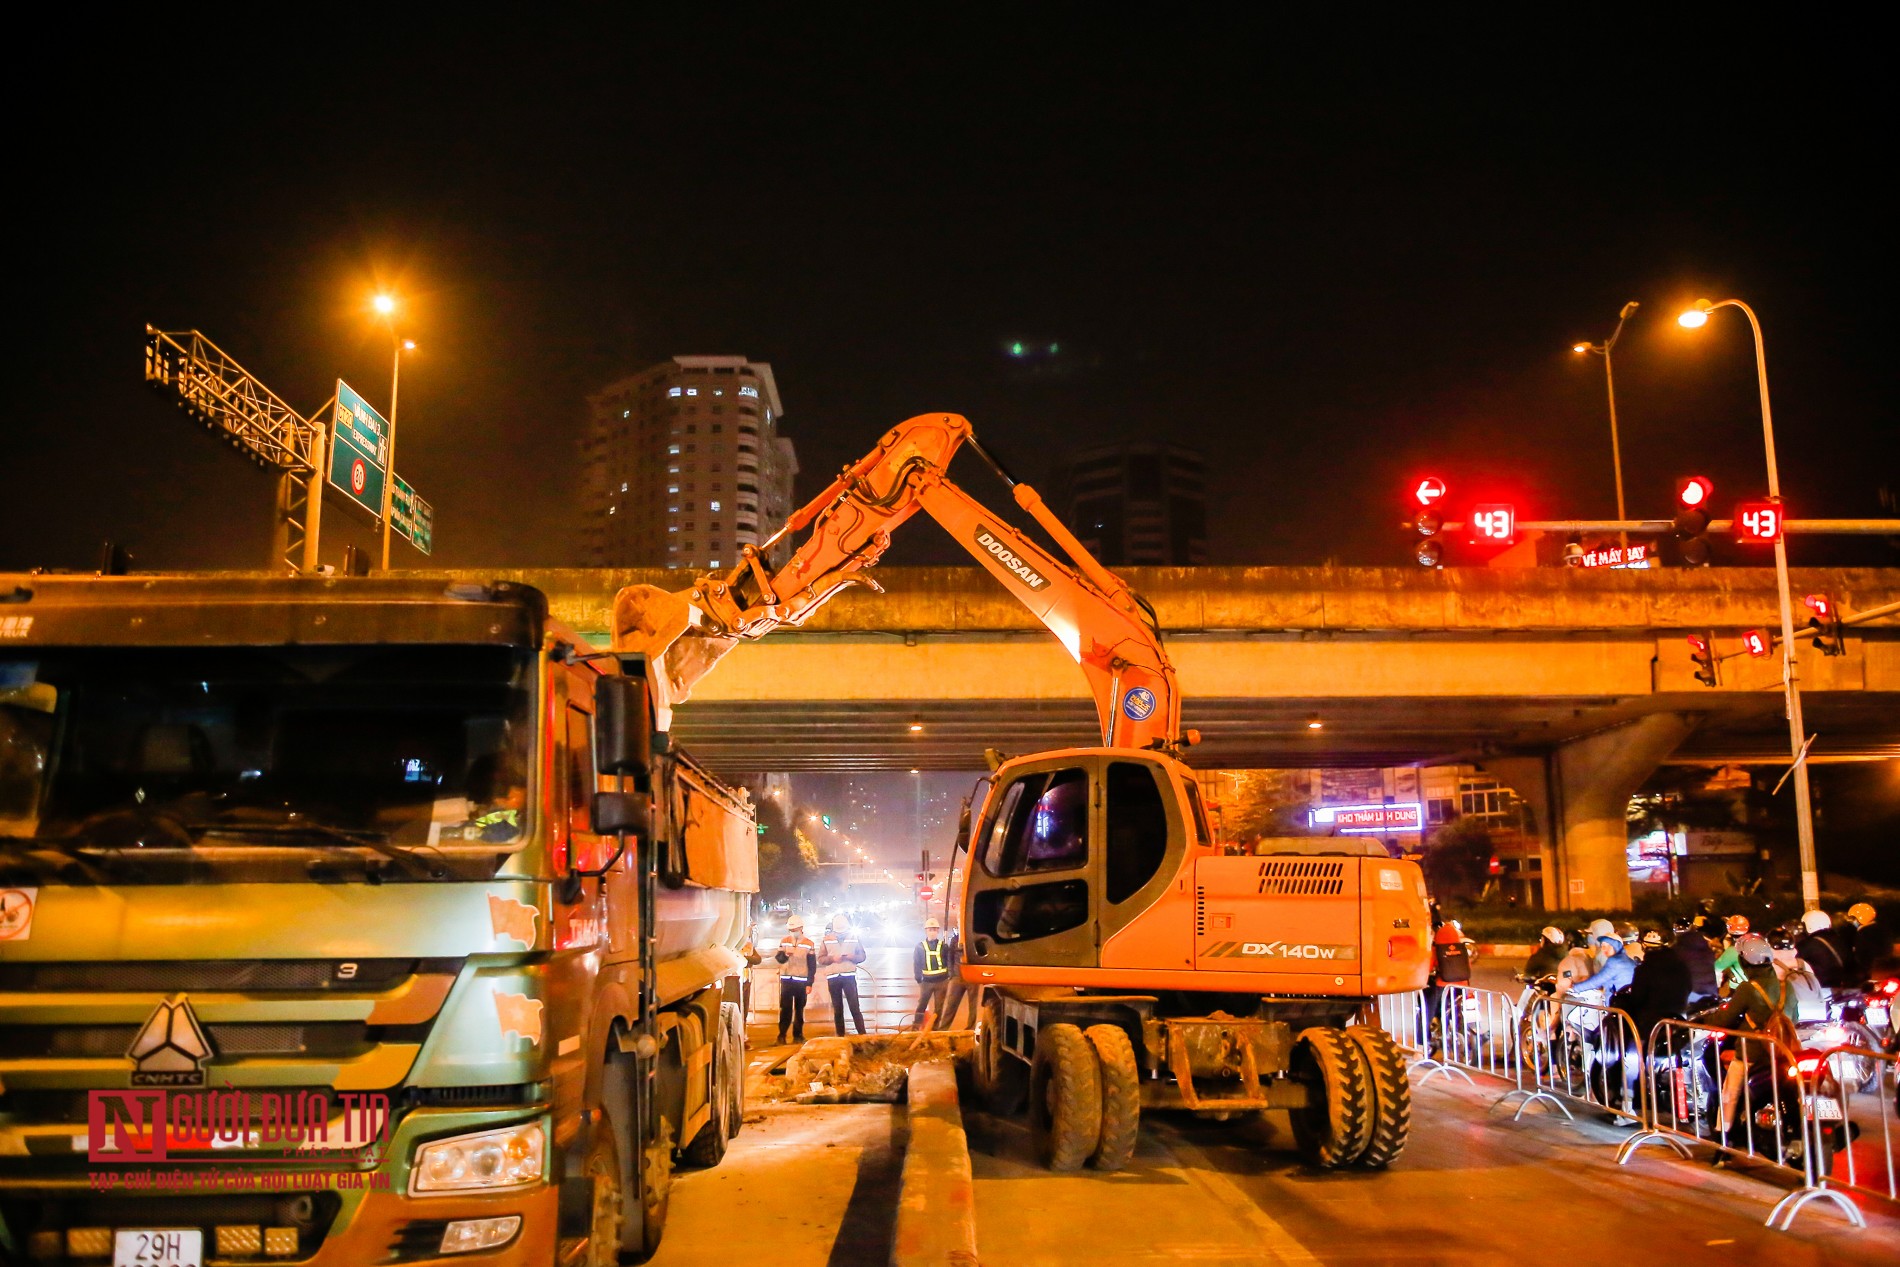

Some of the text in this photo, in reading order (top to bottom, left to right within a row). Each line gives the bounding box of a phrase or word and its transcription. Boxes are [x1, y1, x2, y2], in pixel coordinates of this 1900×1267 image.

[1474, 510, 1510, 539] 43
[1742, 509, 1776, 538] 43
[976, 532, 1044, 588] DOOSAN
[1597, 547, 1622, 566] MÁY
[1337, 809, 1417, 824] KHO THẢM LIH DUNG
[337, 962, 359, 979] 3
[133, 1073, 202, 1085] CNHTC
[135, 1233, 181, 1260] 29H
